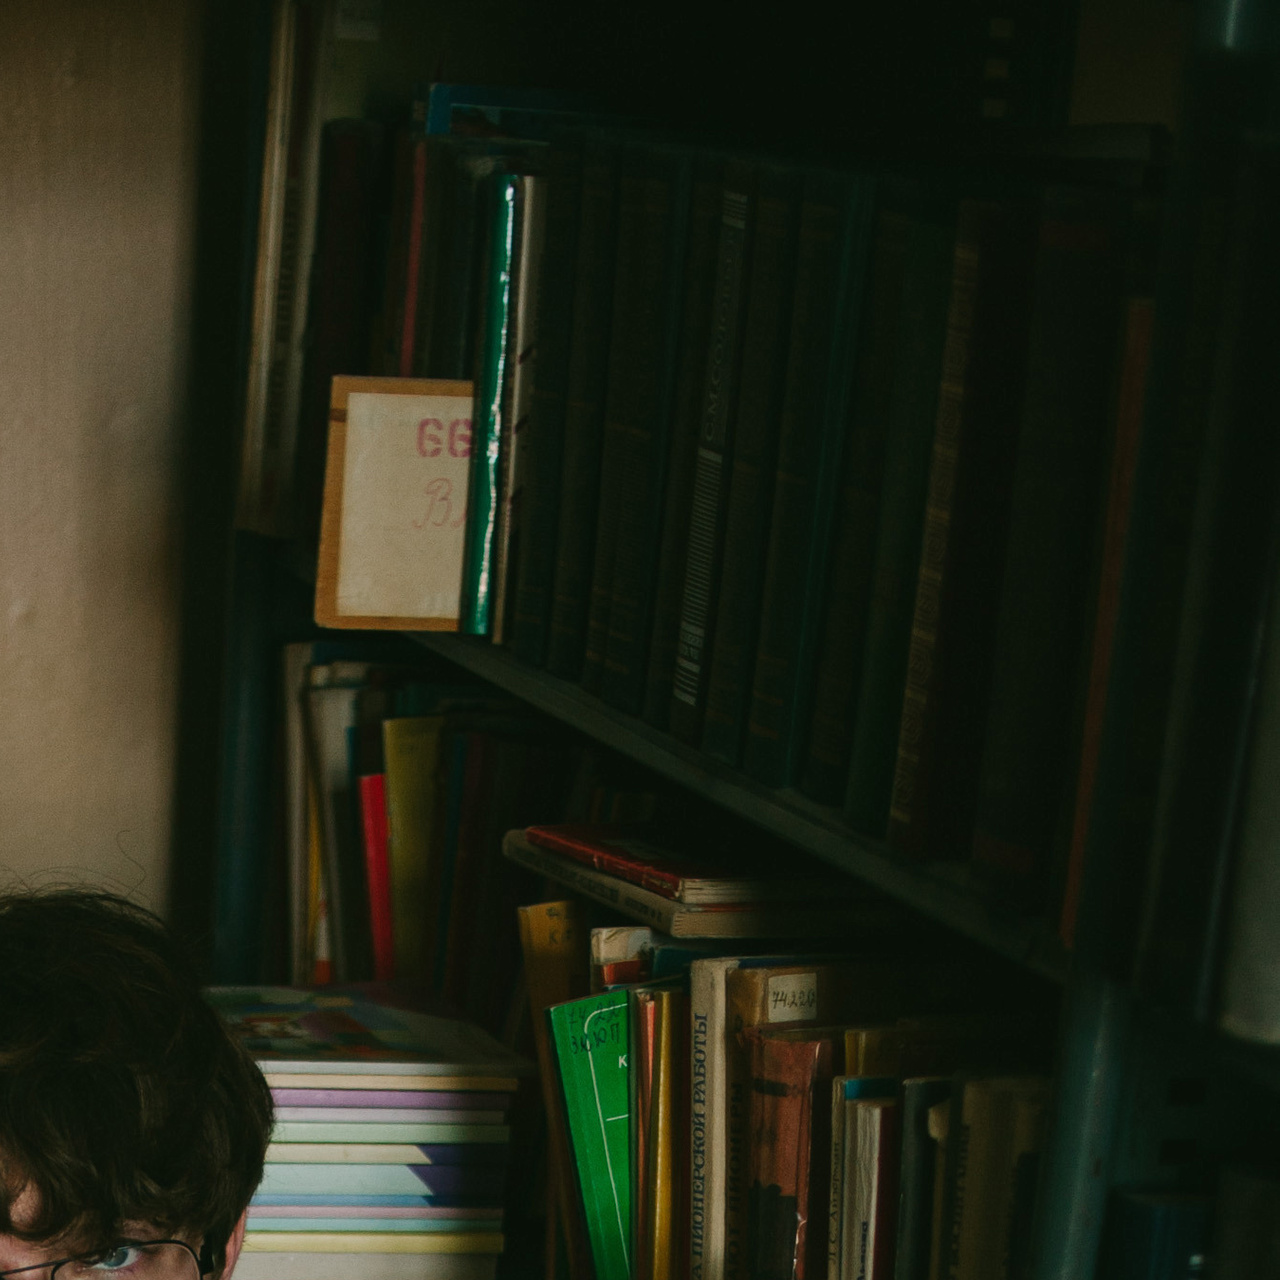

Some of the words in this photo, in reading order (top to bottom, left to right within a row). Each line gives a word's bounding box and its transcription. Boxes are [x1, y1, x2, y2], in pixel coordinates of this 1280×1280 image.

[416, 417, 472, 458] 66
[413, 477, 466, 529] В
[692, 1011, 707, 1105] РАБОТЫ
[690, 1111, 705, 1257] ПИОНЕРСКОЙ
[725, 1082, 743, 1211] ПИОНЕРЫ
